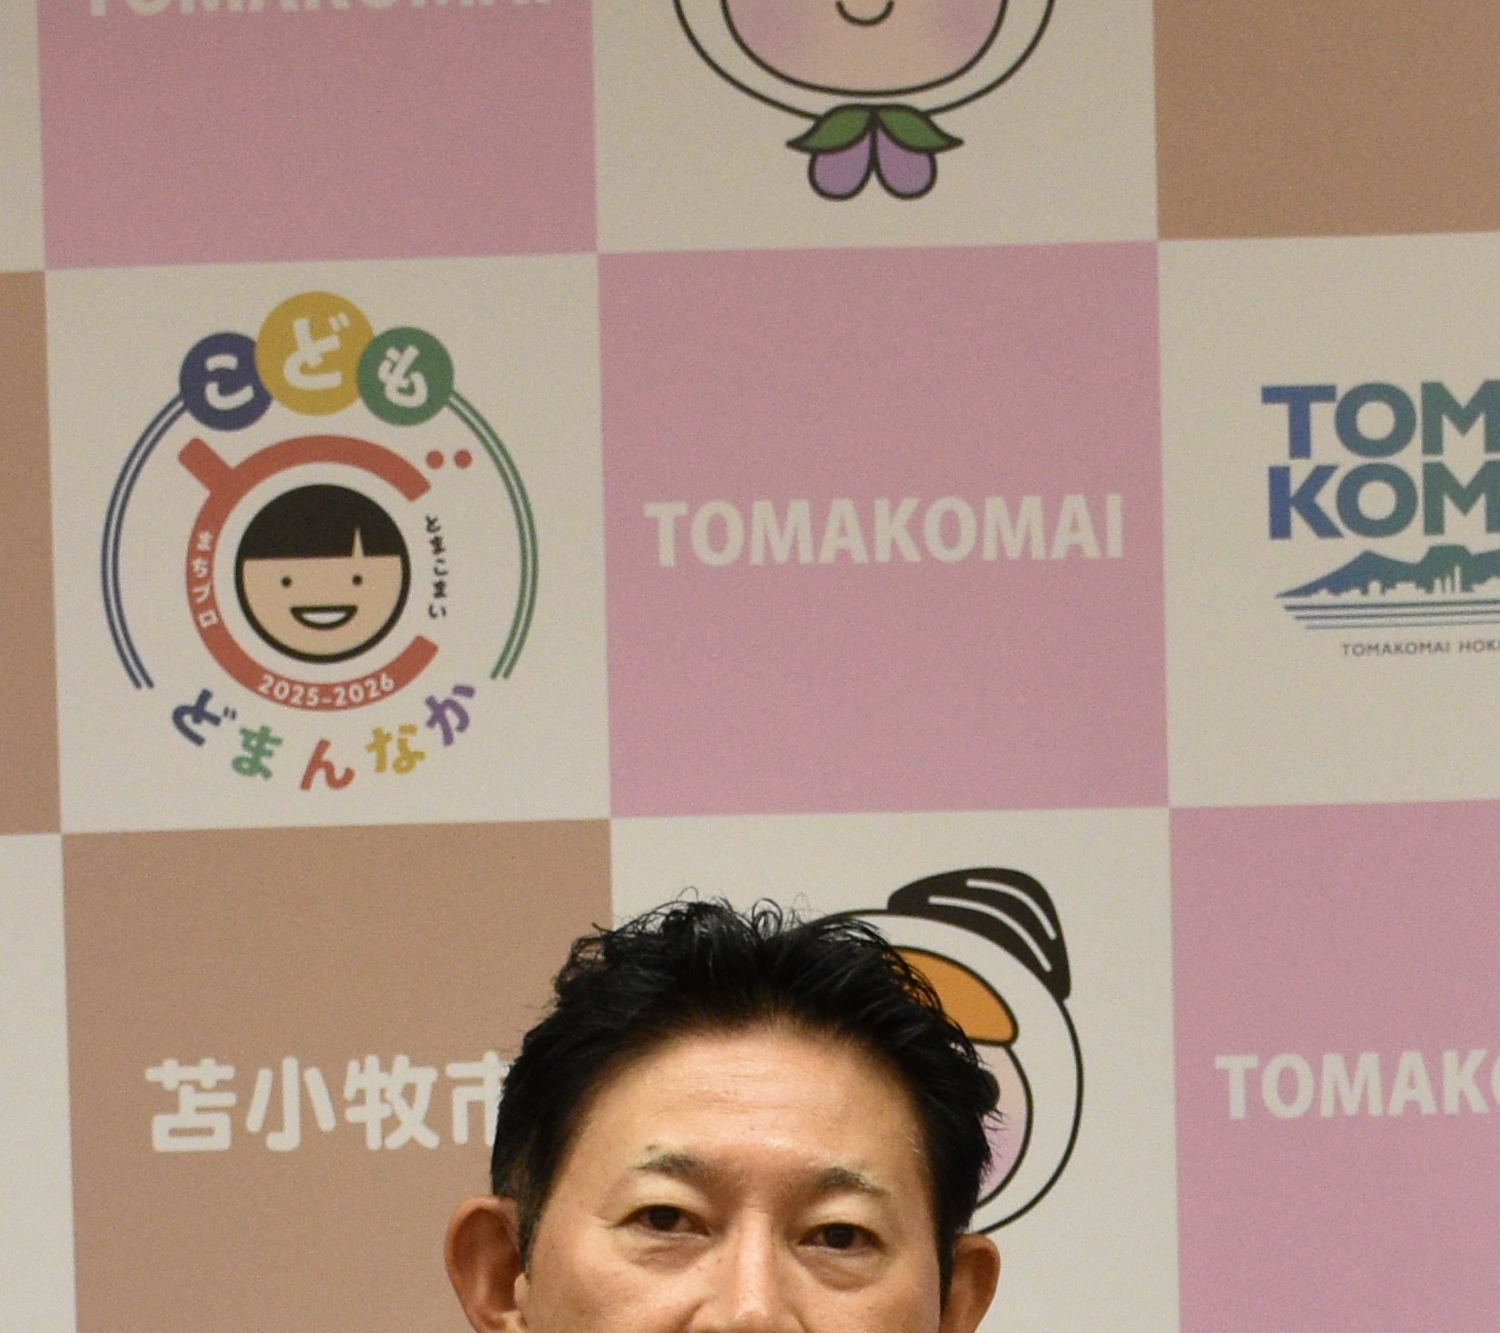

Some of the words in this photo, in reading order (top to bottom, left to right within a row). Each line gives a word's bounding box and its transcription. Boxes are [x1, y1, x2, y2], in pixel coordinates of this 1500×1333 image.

[203, 312, 429, 408] こども
[644, 493, 1123, 567] TOMAKOMAI
[1341, 640, 1451, 658] TOMAKOMAI
[256, 671, 396, 708] 2025-2026
[171, 685, 476, 791] どまんなか
